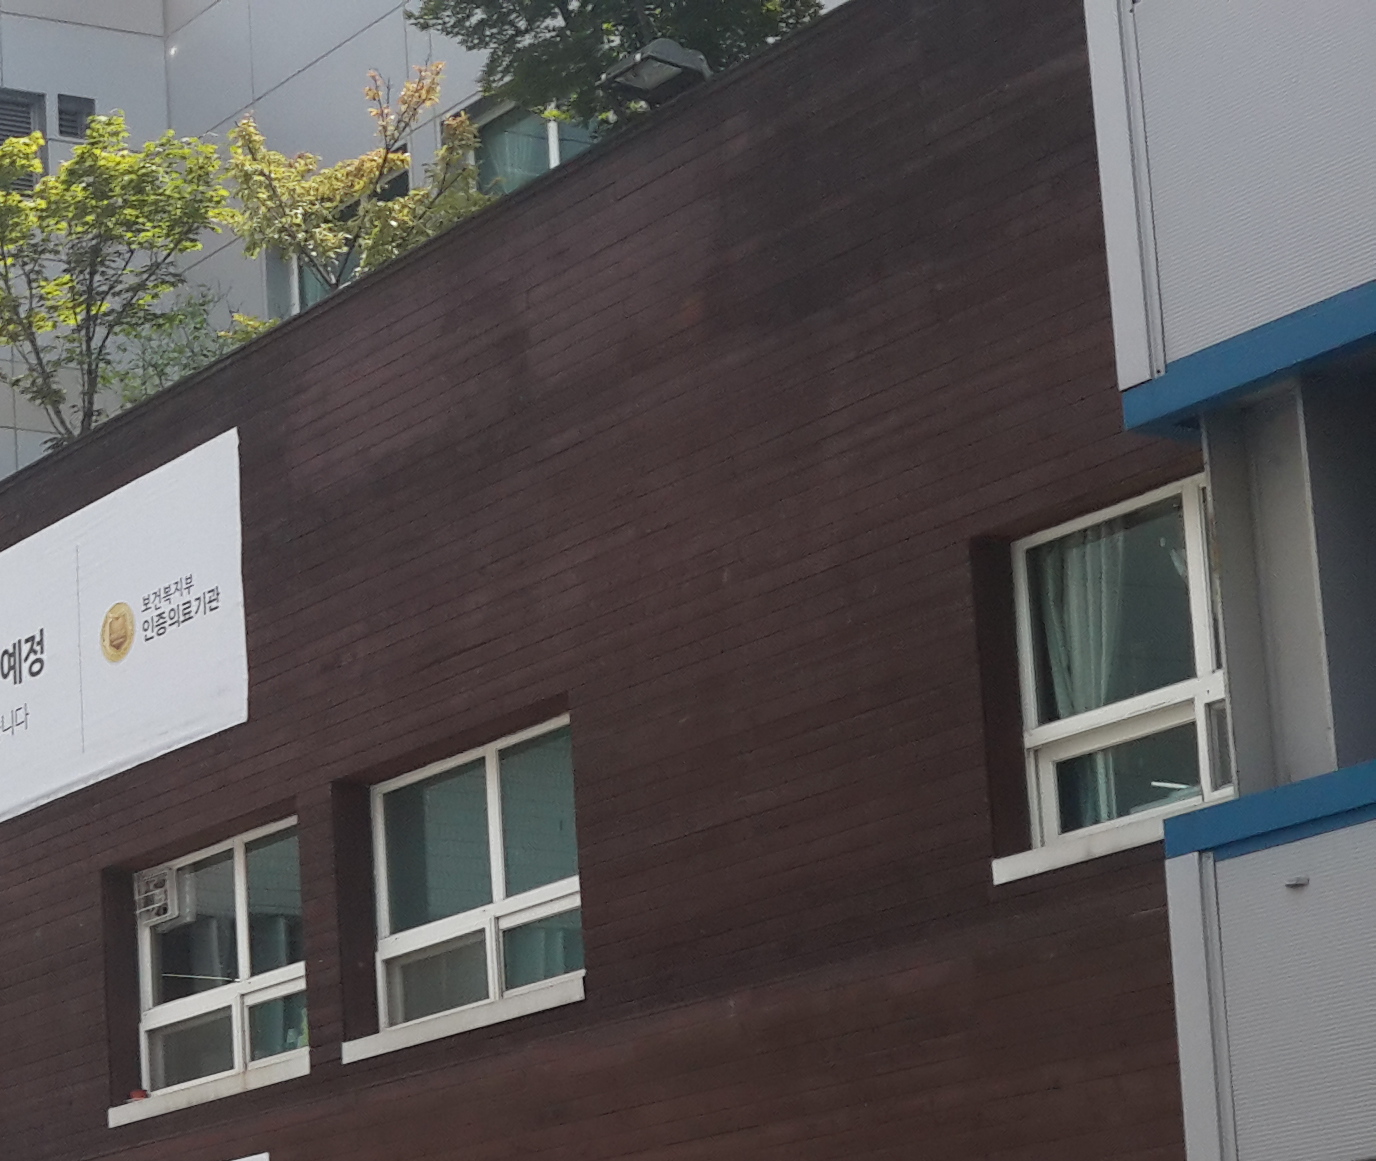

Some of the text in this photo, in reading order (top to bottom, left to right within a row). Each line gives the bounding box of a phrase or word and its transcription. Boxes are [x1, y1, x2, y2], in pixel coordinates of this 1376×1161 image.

[141, 573, 195, 613] 보건복지부
[142, 585, 220, 643] 인증의료기관
[0, 627, 45, 685] 예정
